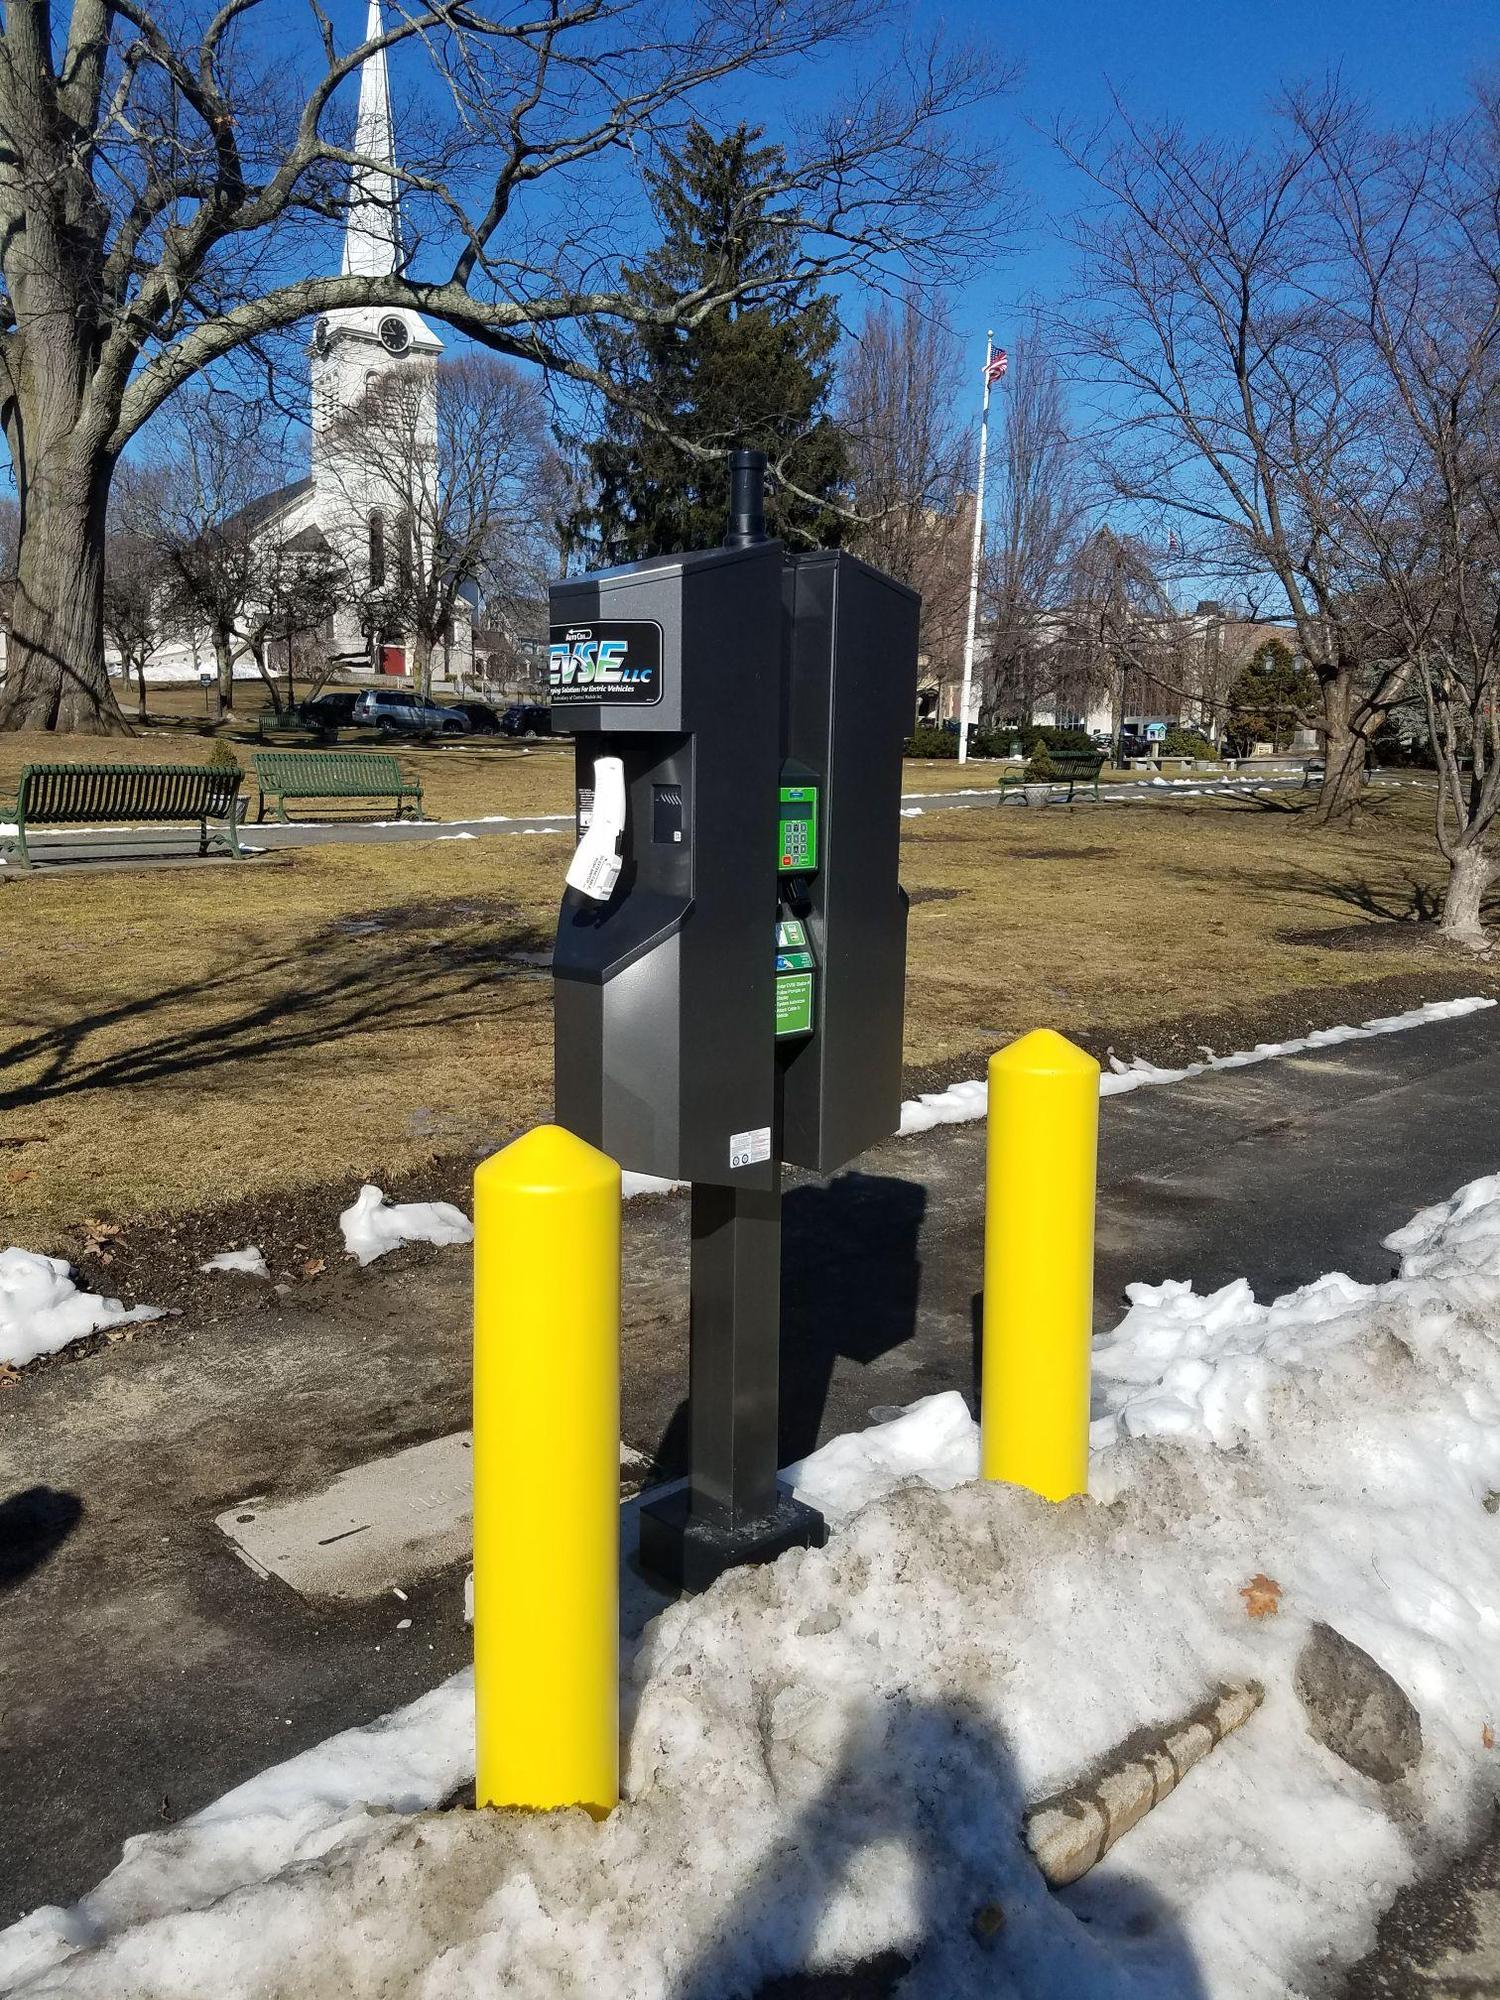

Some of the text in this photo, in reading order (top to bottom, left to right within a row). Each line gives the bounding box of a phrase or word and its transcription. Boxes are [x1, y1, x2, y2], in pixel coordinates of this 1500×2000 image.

[622, 668, 652, 683] LLC
[588, 684, 607, 692] Electric
[607, 683, 635, 692] Vehicles
